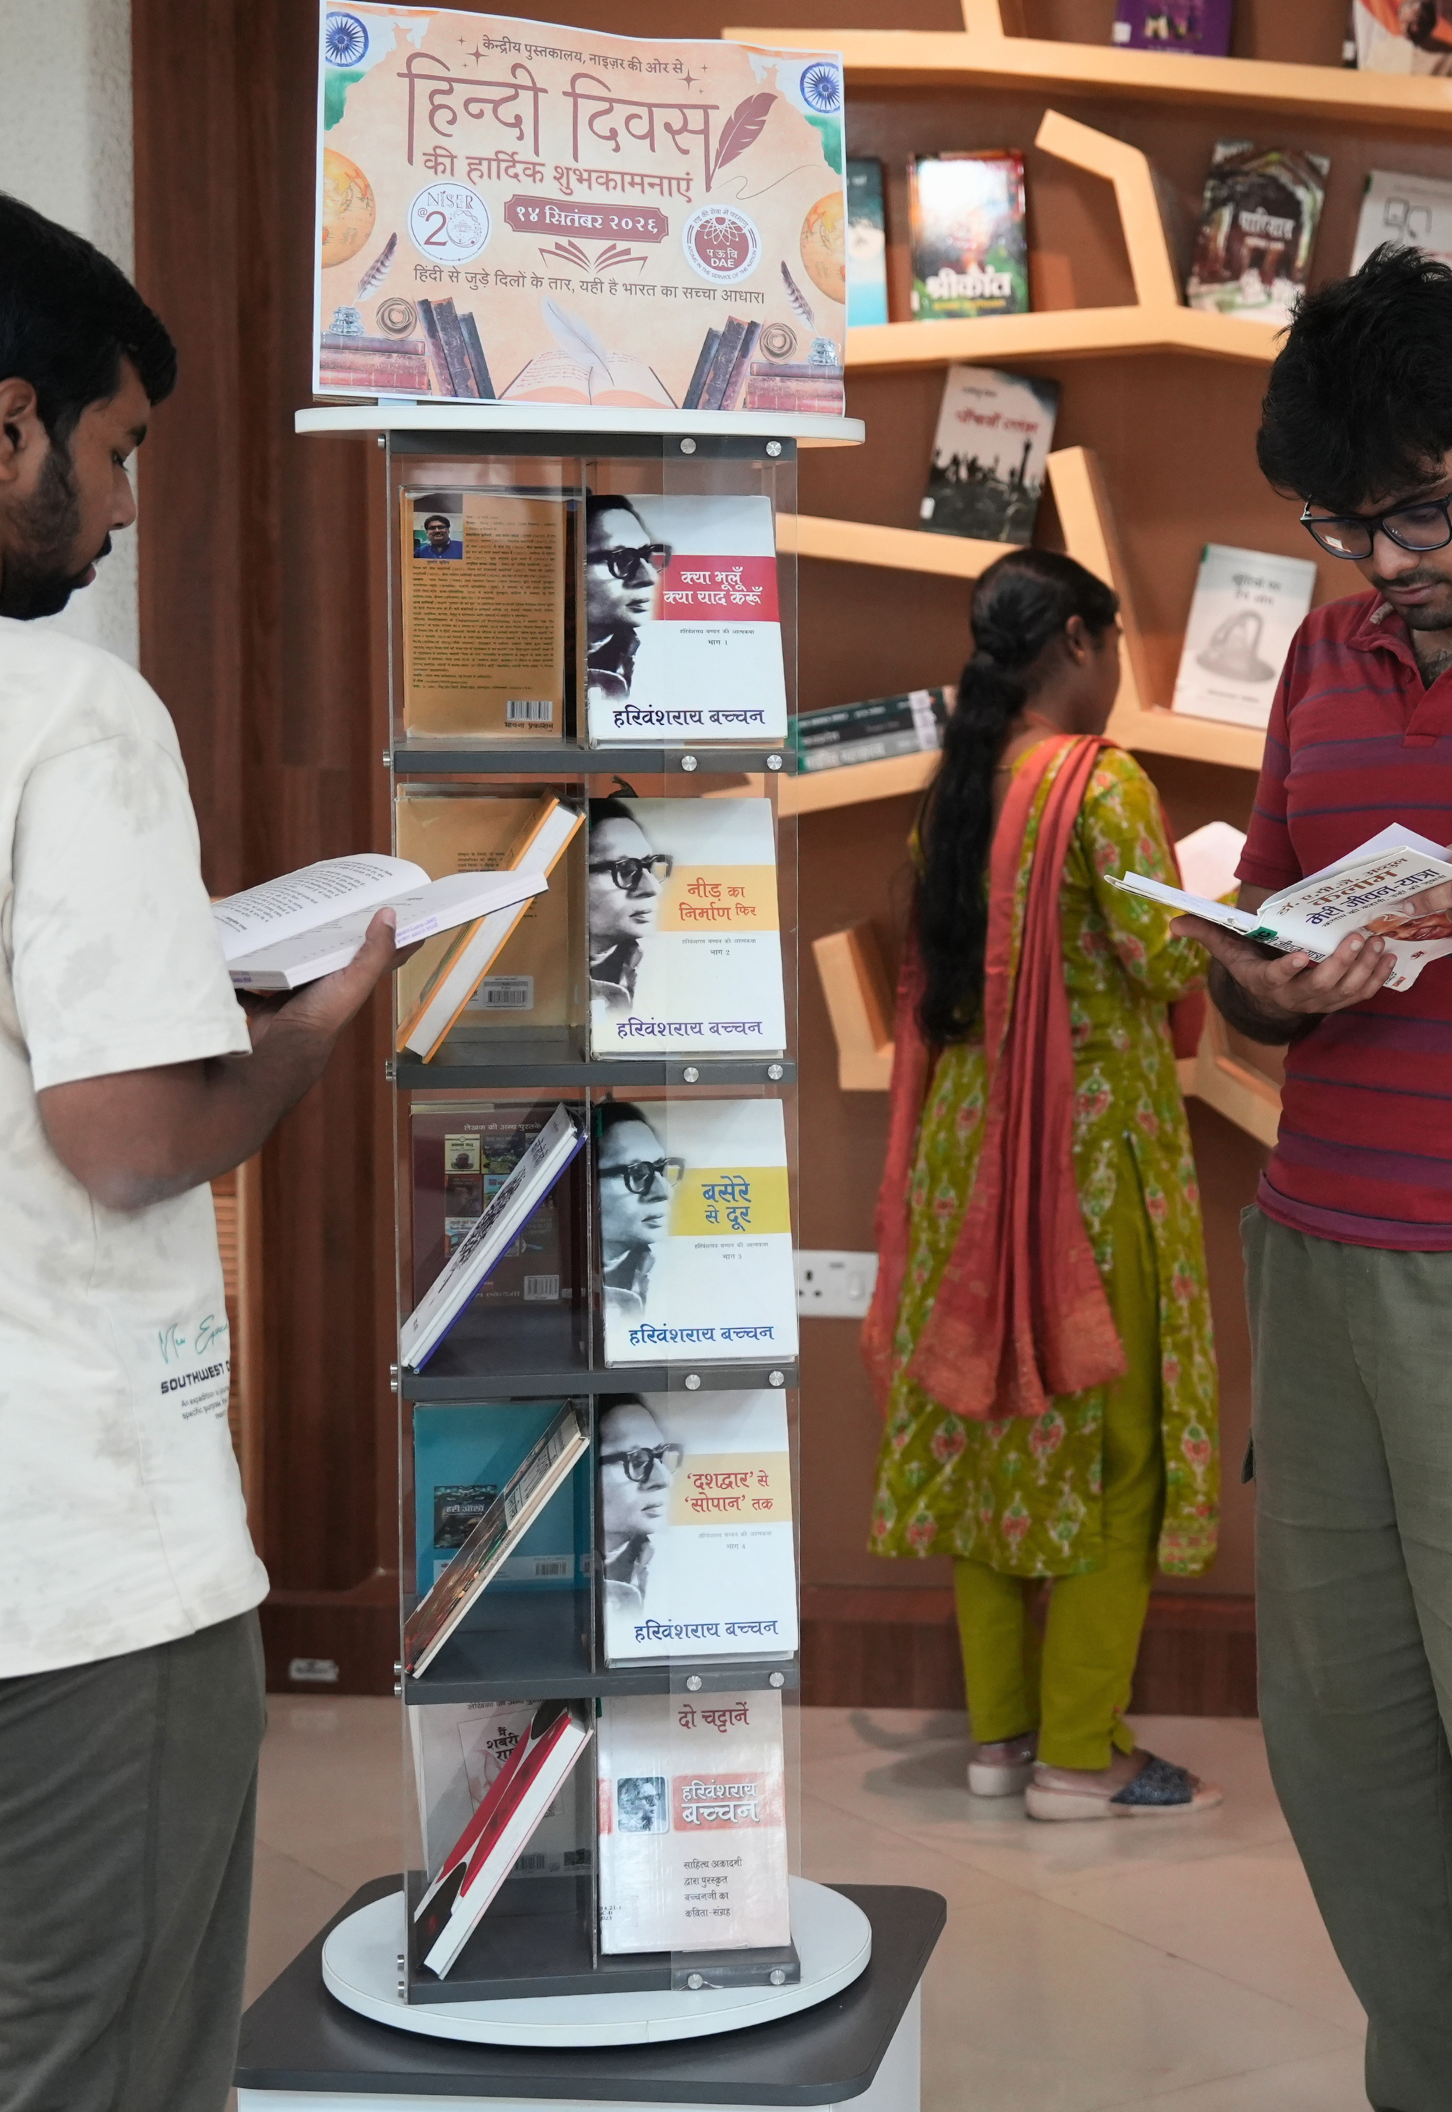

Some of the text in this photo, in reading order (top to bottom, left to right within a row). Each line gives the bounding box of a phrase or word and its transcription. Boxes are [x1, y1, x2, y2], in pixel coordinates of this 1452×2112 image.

[483, 35, 684, 74] केन्द्रीय पुस्तकालय, नाइज़र की ओर से
[397, 51, 719, 192] हिन्दी दिवस
[423, 146, 693, 203] की हार्दिक शुभकामनाएं
[427, 190, 473, 209] NISER
[516, 205, 658, 234] १४ सितंबर २०२६
[711, 258, 735, 268] DAE
[413, 264, 444, 282] हिंदी
[448, 266, 461, 283] से
[465, 268, 491, 291] जुड़े
[494, 270, 527, 288] दिलों
[531, 272, 544, 289] के
[548, 277, 575, 293] तार,
[579, 277, 604, 295] यही
[608, 278, 619, 296] है
[622, 283, 657, 297] भारत
[661, 284, 679, 298] का
[682, 286, 717, 300] सच्चा
[681, 566, 744, 590] क्या भूलूँ
[663, 586, 763, 606] क्या याद करूँ
[613, 704, 766, 729] हरिवंशराय बच्चन
[687, 877, 745, 901] नीड़ का
[1306, 869, 1440, 924] मेरी जीवन-यात्रा
[1307, 870, 1397, 906] कलाम
[679, 902, 757, 921] निर्माण फिर
[617, 1016, 763, 1039] हरिवंशराय बच्चन
[464, 1123, 485, 1131] लेखक
[702, 1175, 752, 1203] बसेरे
[705, 1205, 752, 1232] से दूर
[629, 1323, 775, 1346] हरिवंशराय बच्चन
[161, 1362, 225, 1394] SOUTHWEST
[757, 1470, 770, 1488] से
[752, 1498, 773, 1511] तक
[634, 1619, 779, 1643] हरिवंशराय बच्चन
[678, 1701, 749, 1733] दो चट्टानें
[487, 1732, 519, 1750] शबरी
[498, 1727, 507, 1736] मैं
[682, 1779, 757, 1801] हरिवंशराय
[681, 1801, 760, 1825] बच्चन
[683, 1856, 742, 1870] साहित्य अकादमी
[684, 1876, 728, 1888] द्वारा पुरस्कृत
[684, 1890, 729, 1901] बच्चनजी का
